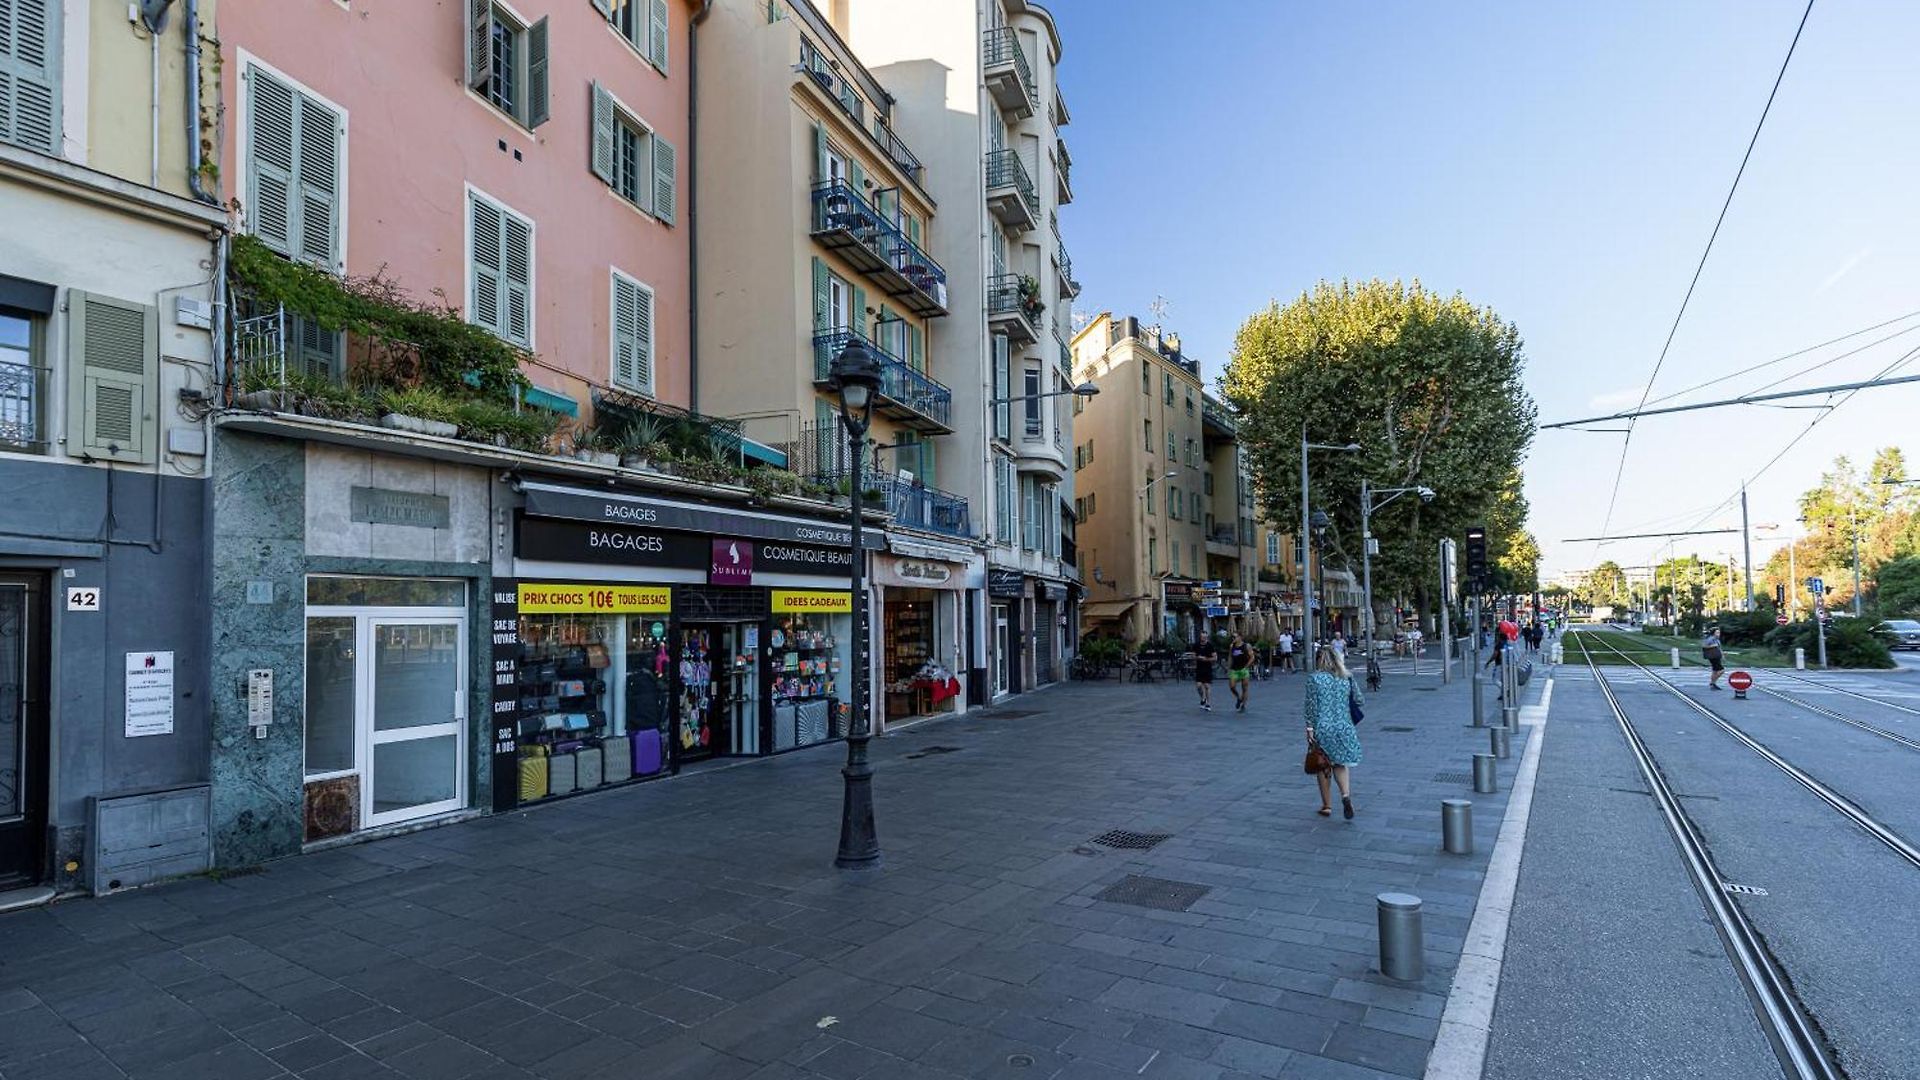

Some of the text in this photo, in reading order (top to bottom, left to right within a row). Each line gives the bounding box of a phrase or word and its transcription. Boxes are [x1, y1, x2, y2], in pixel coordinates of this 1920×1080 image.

[605, 504, 657, 522] BAGAGES
[590, 531, 663, 552] BAGAGES
[795, 527, 842, 543] COSMETIQUE
[763, 545, 826, 563] COSMETIQUE
[71, 592, 96, 606] 42
[494, 592, 516, 604] VALISE
[523, 591, 667, 608] PRIX CHOCS 10€ TOUS LES SACS
[784, 597, 847, 607] IDEES CADEAUX
[494, 620, 517, 631] SAC DE
[496, 660, 509, 672] SAC
[496, 673, 514, 685] MAIN
[498, 727, 512, 740] SAC
